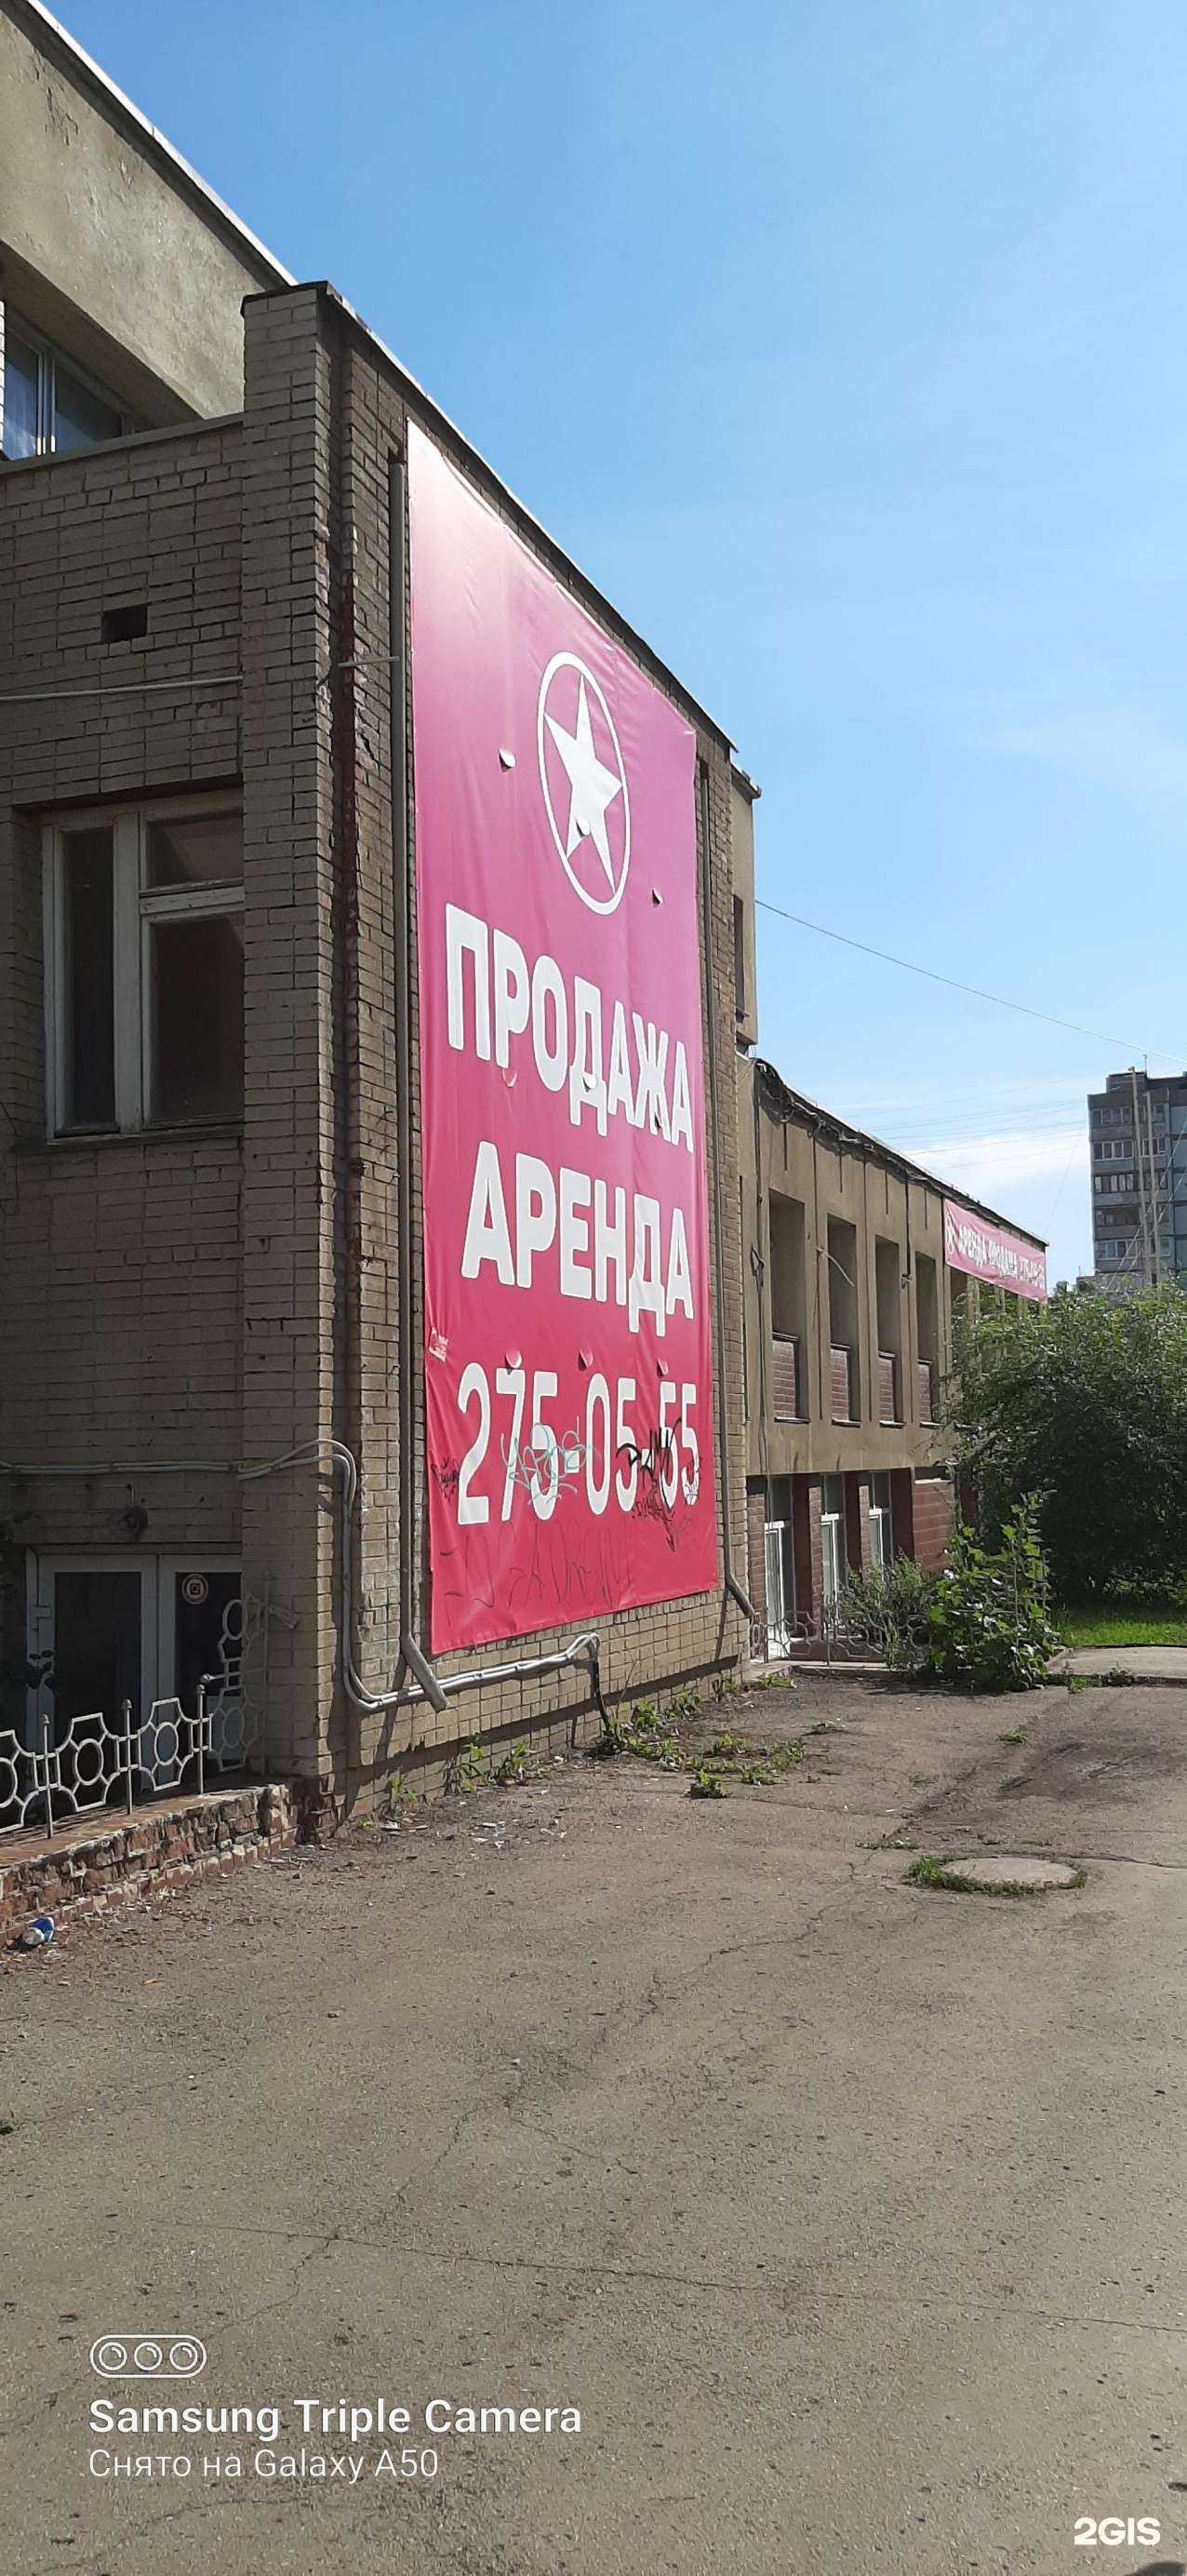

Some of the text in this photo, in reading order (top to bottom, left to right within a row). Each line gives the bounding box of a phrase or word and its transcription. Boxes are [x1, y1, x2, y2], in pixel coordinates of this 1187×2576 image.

[445, 902, 694, 1154] ПРОДАЖА
[460, 1140, 694, 1337] АРЕНДА
[457, 1362, 700, 1525] 275-05-55
